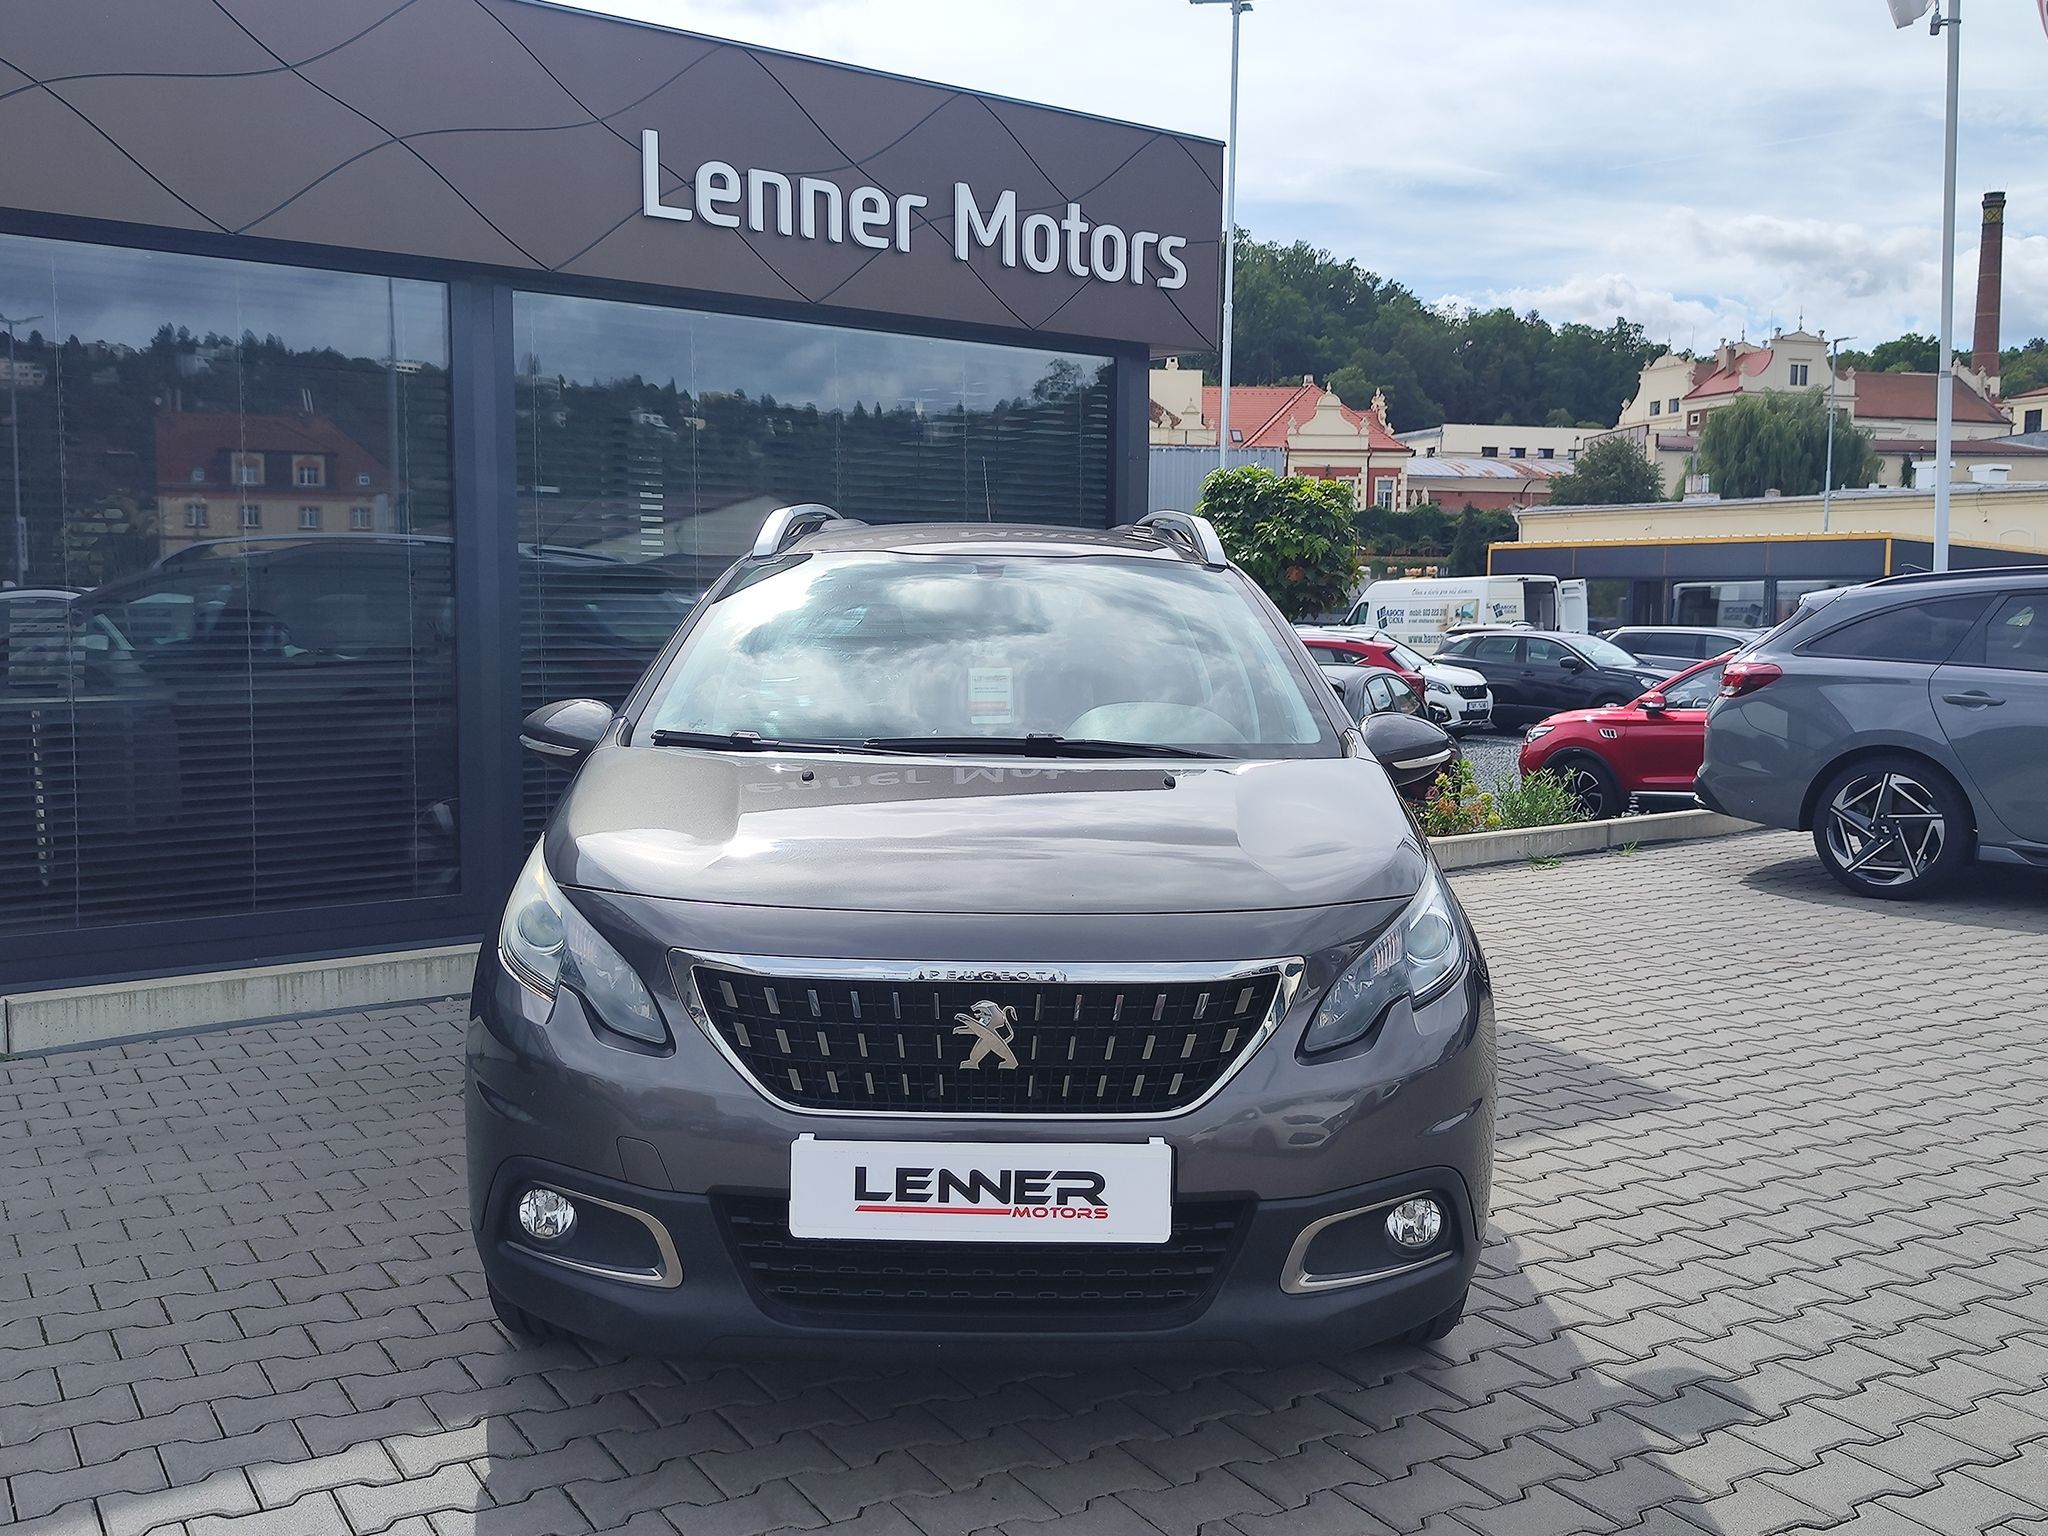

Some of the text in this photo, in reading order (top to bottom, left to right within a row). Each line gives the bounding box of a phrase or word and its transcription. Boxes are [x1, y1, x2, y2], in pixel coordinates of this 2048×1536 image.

[642, 129, 1188, 289] Lenner Motors
[930, 970, 1047, 981] PEUGEOT
[854, 1166, 1109, 1207] LENNER
[1012, 1206, 1109, 1220] MOTORS
